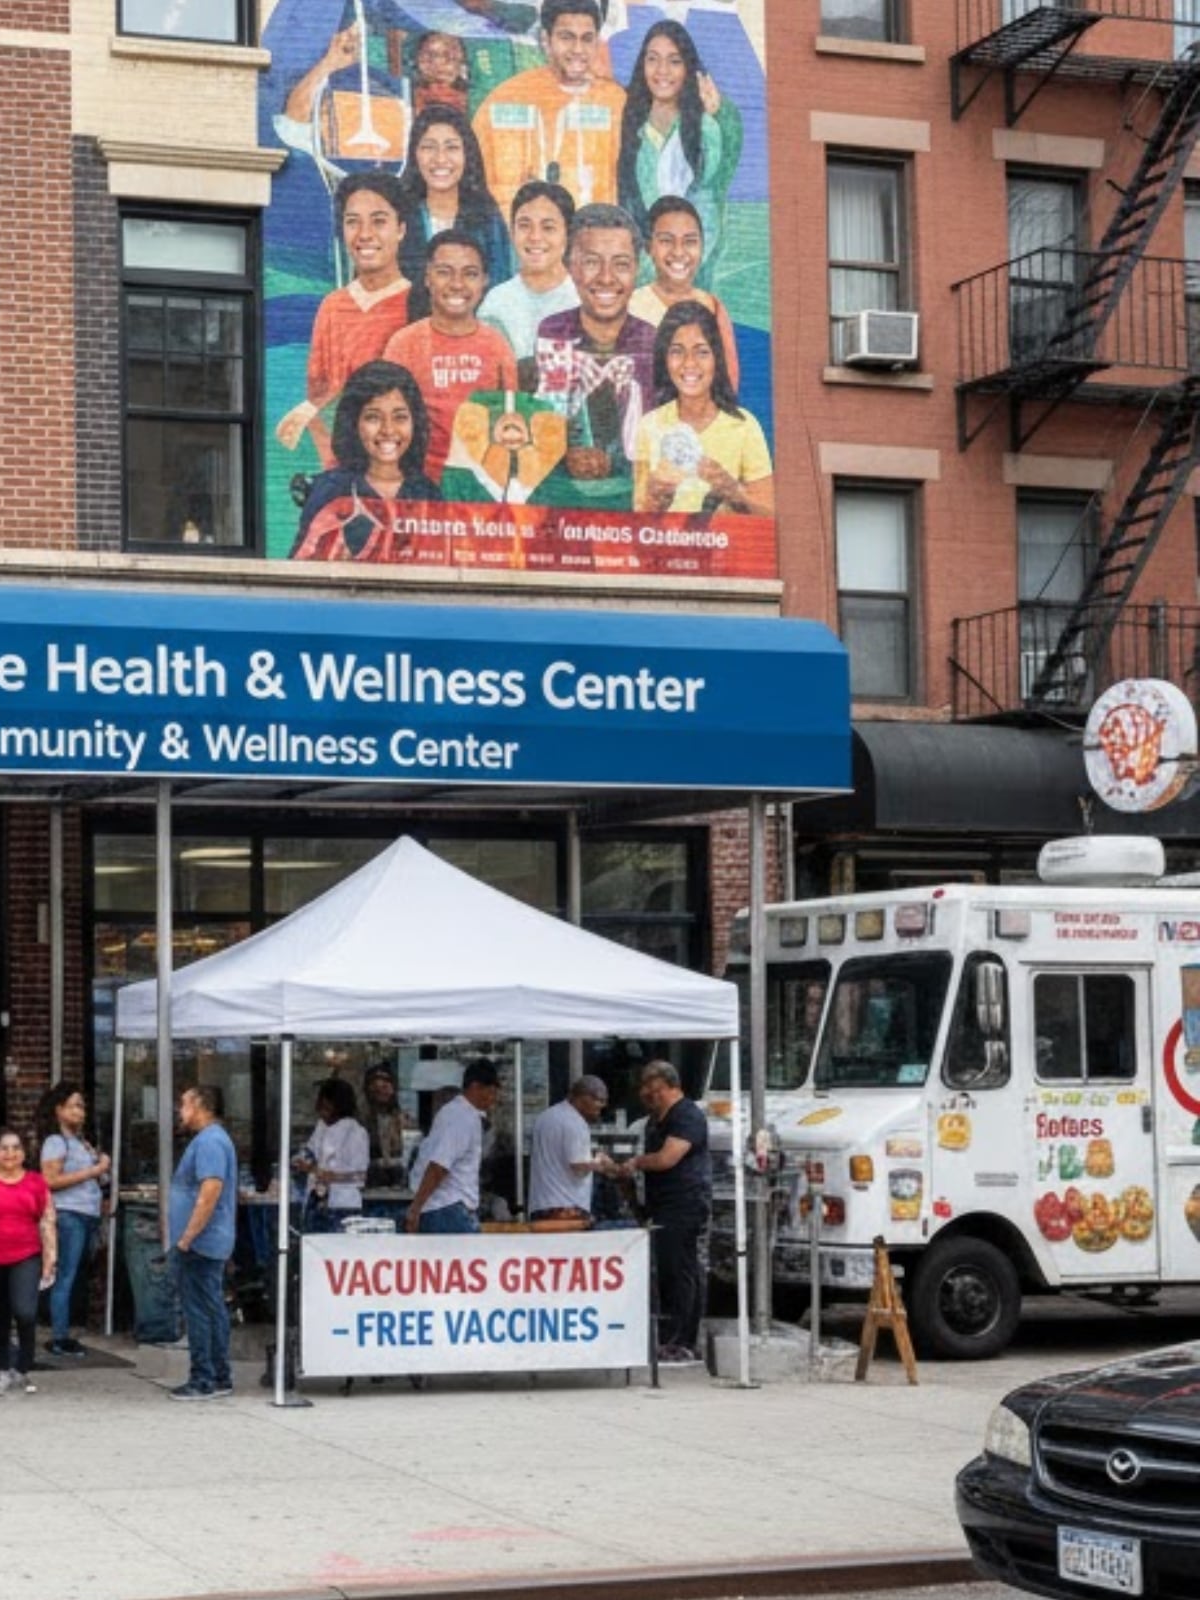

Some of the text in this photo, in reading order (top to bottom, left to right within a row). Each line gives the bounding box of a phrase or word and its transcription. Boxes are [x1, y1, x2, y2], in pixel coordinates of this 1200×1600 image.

[47, 643, 227, 697] Health
[245, 650, 287, 699] &
[300, 652, 526, 707] Wellness
[542, 661, 705, 712] Center
[159, 722, 190, 761] &
[203, 724, 378, 765] Wellness
[389, 729, 519, 769] Center
[325, 1256, 625, 1296] VACUNAS GRTAIS
[356, 1310, 434, 1347] FREE
[444, 1306, 600, 1345] VACCINES
